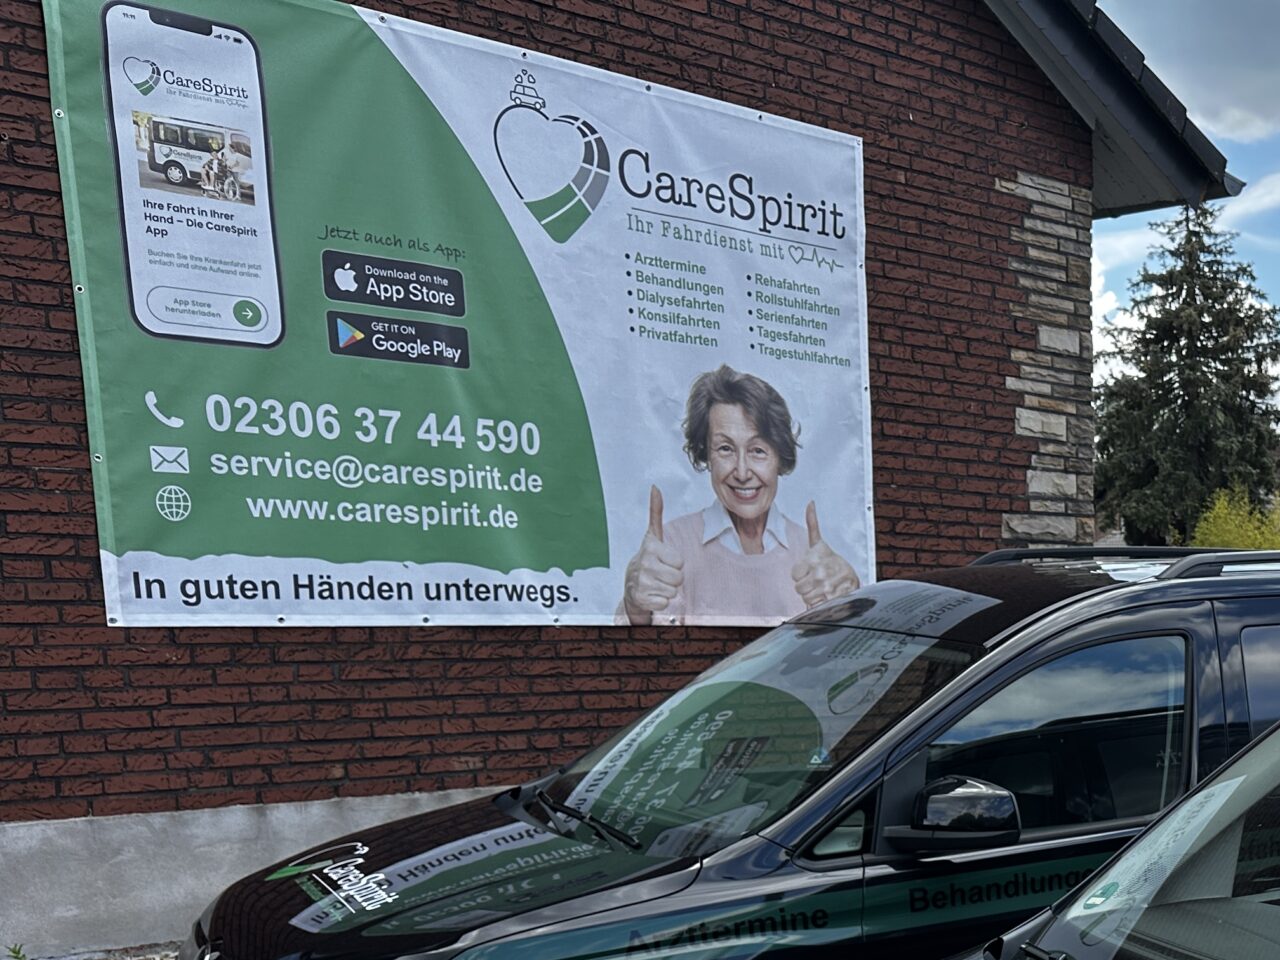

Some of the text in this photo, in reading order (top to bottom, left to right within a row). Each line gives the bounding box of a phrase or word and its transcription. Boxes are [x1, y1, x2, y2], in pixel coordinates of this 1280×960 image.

[163, 69, 249, 100] CareSpirit
[618, 148, 846, 240] CareSpirit
[143, 199, 235, 221] Ihre Fahrt in Ihrer
[144, 212, 174, 225] Hand
[186, 218, 203, 229] Die
[206, 221, 258, 238] CareSpirit
[145, 225, 169, 238] App
[626, 213, 785, 261] Ihr Fahrdienst mit
[147, 249, 175, 259] Buchen
[176, 252, 188, 260] Sie
[318, 224, 466, 263] Jetzt auch als App:
[364, 264, 449, 286] Download on the
[635, 251, 707, 275] Arzttermine
[366, 277, 456, 306] App Store
[635, 270, 725, 296] Behandlungen
[755, 272, 821, 296] Rehafahrten
[173, 297, 212, 309] App Store
[636, 288, 725, 314] Dialysefahrten
[755, 290, 841, 317] Rollstuhlfahrten
[371, 321, 416, 336] GET IT ON
[637, 306, 721, 330] Konsilfahrten
[756, 307, 828, 331] Serienfahrten
[372, 333, 462, 363] Google Play
[638, 325, 718, 347] Privatfahrten
[756, 325, 826, 348] Tagesfahrten
[757, 342, 852, 368] Tragestuhlfahrten
[204, 393, 541, 457] 02306 37 44 590
[209, 449, 544, 494] service@carespirit.de
[245, 494, 520, 532] www.carespirit.de
[132, 570, 580, 609] In guten Händen unterwegs.
[322, 857, 400, 911] CareSpirit
[624, 907, 830, 960] Arzttermine
